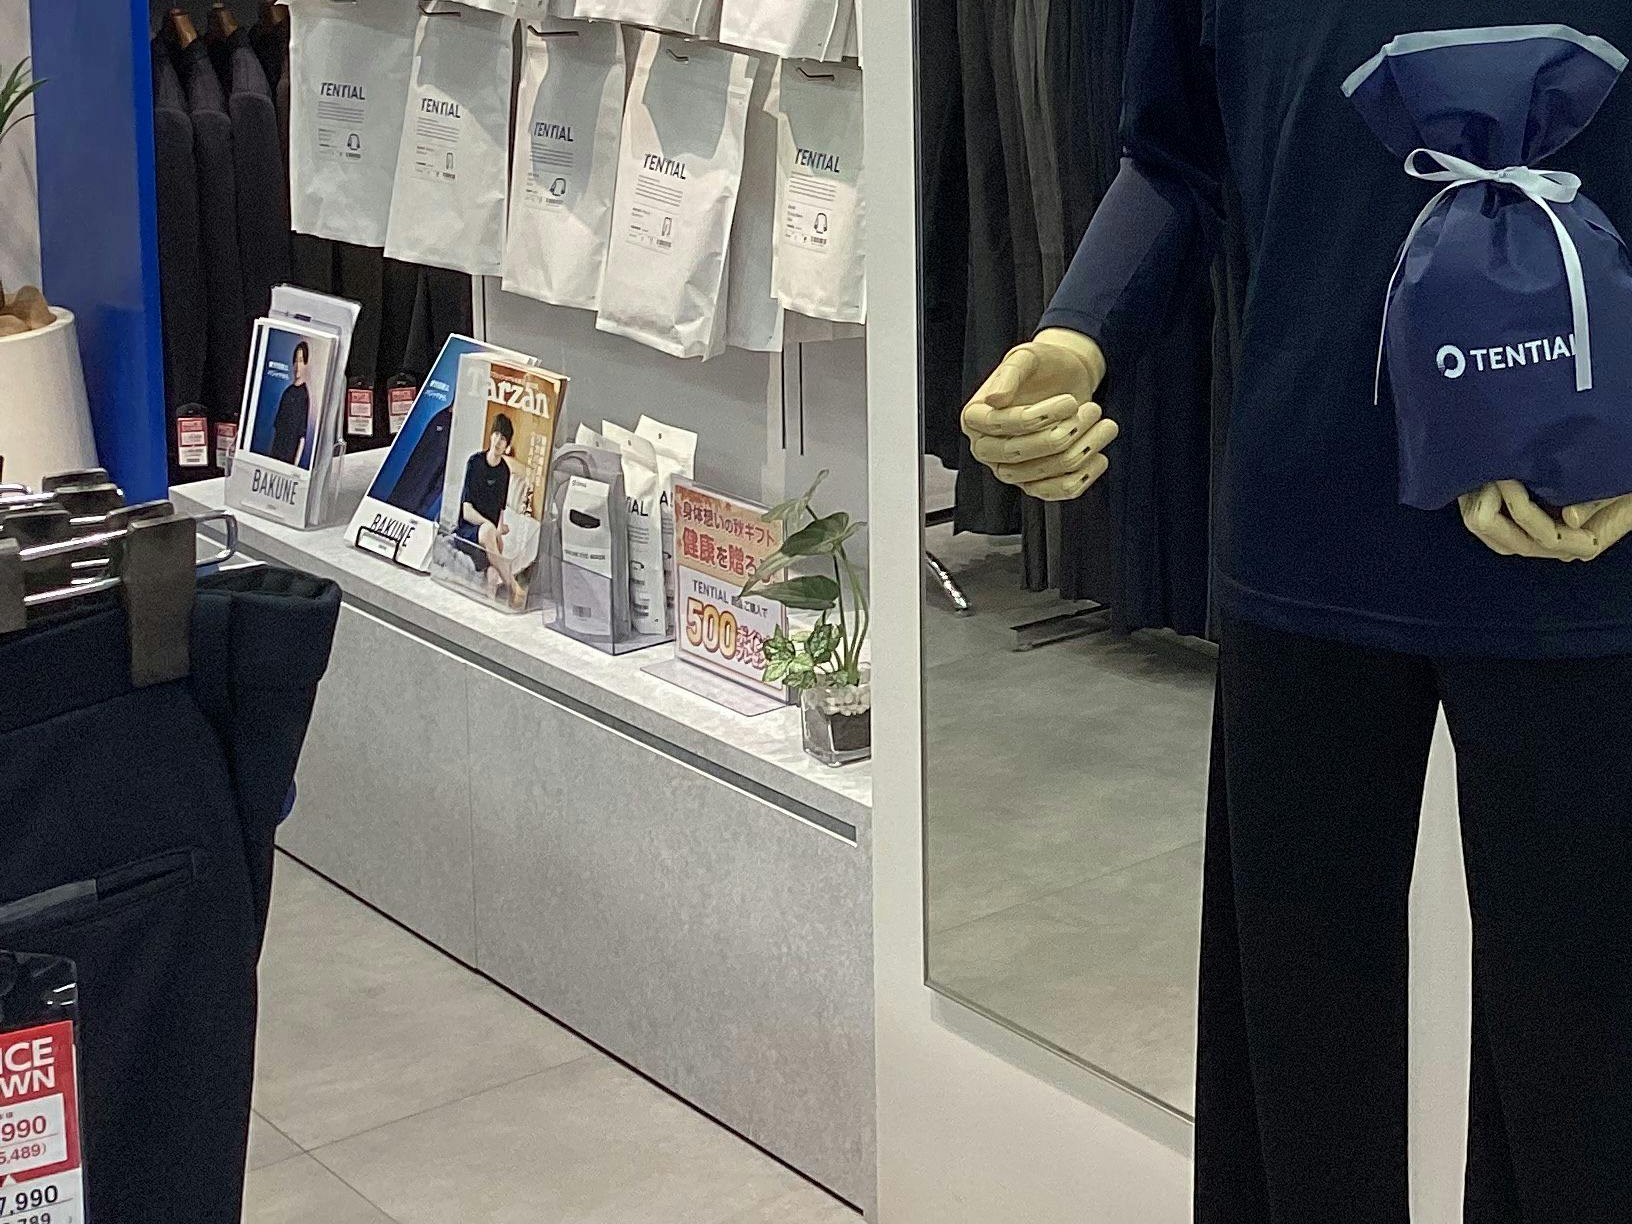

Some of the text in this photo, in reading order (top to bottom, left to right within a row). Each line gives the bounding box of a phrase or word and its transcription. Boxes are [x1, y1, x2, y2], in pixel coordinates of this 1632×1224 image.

[319, 82, 366, 102] TENTIAL
[420, 97, 462, 120] TENTIAL
[533, 121, 575, 144] TENTIAL
[642, 153, 687, 180] TENTIAL
[794, 147, 841, 173] TENTIAL
[251, 469, 299, 506] BAKUNE
[370, 513, 416, 548] BAKUNE
[692, 580, 729, 605] TENTIAL
[686, 596, 738, 661] 500
